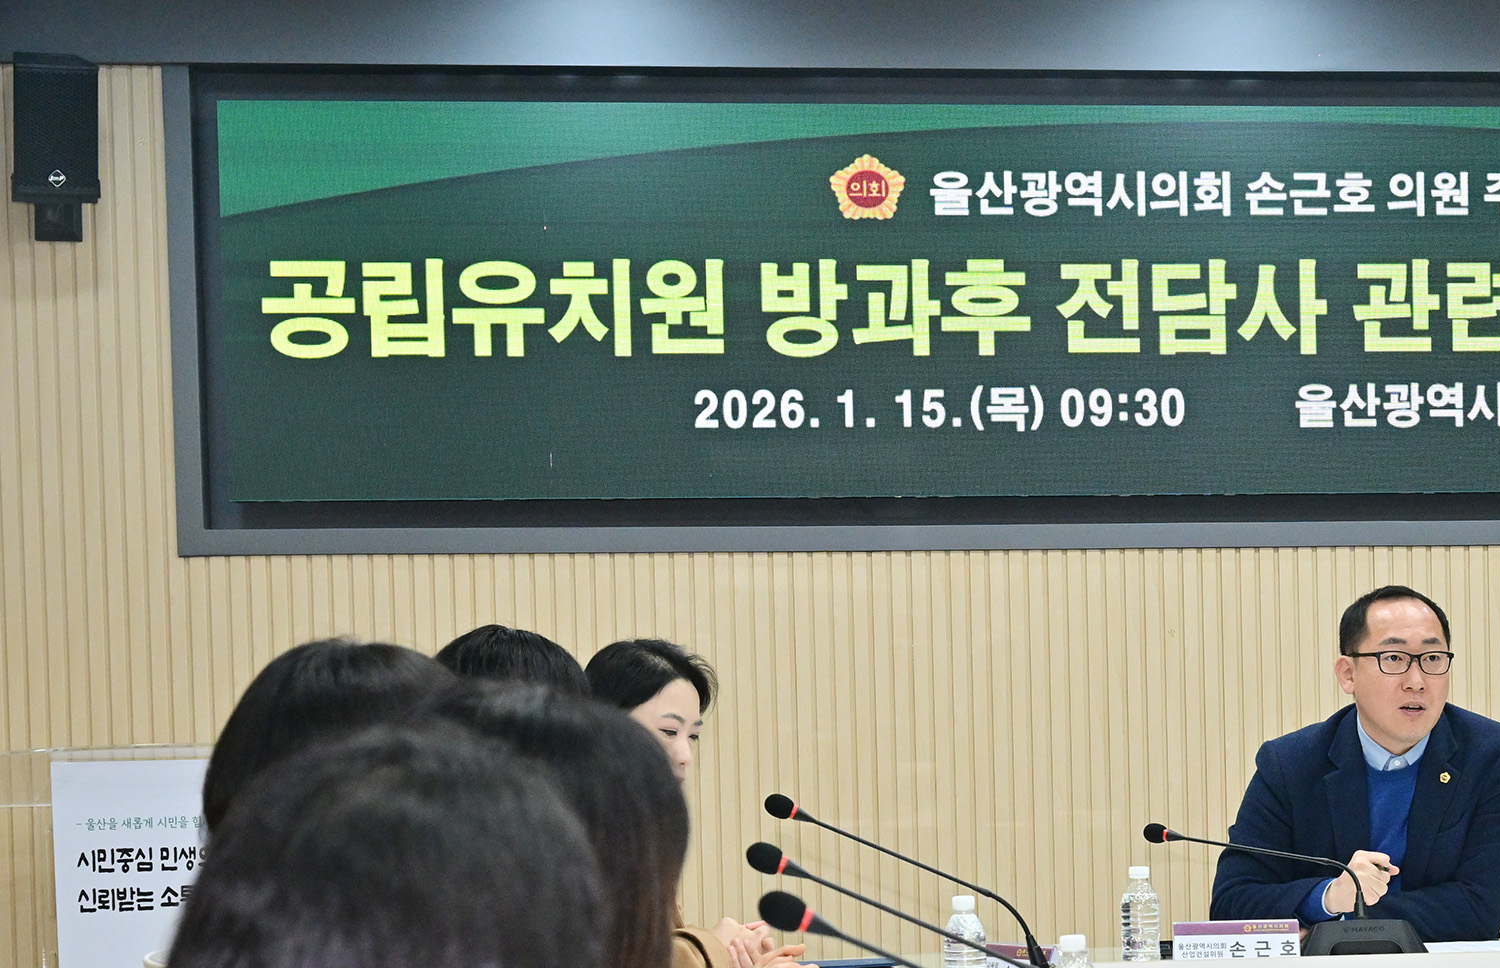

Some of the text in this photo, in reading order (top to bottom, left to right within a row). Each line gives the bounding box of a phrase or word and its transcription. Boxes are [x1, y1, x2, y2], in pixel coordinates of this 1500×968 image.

[848, 179, 886, 198] 의회
[929, 171, 1233, 218] 울산광역시의회
[1246, 172, 1376, 217] 손근호
[1387, 172, 1470, 218] 의원
[261, 258, 727, 360] 공립유치원
[761, 258, 1032, 360] 방과후
[1056, 258, 1328, 356] 전담사
[694, 385, 1187, 433] 2026. 1. 15.(목) 09:30
[85, 817, 118, 831] 울산을
[121, 817, 154, 830] 새롭게
[157, 815, 189, 829] 시민을
[77, 847, 154, 874] 시민중심
[77, 886, 155, 914] 신뢰받는
[1177, 942, 1227, 951] 울산광역시의회
[1181, 951, 1224, 959] 산업건설위원
[1229, 939, 1297, 958] 손근호
